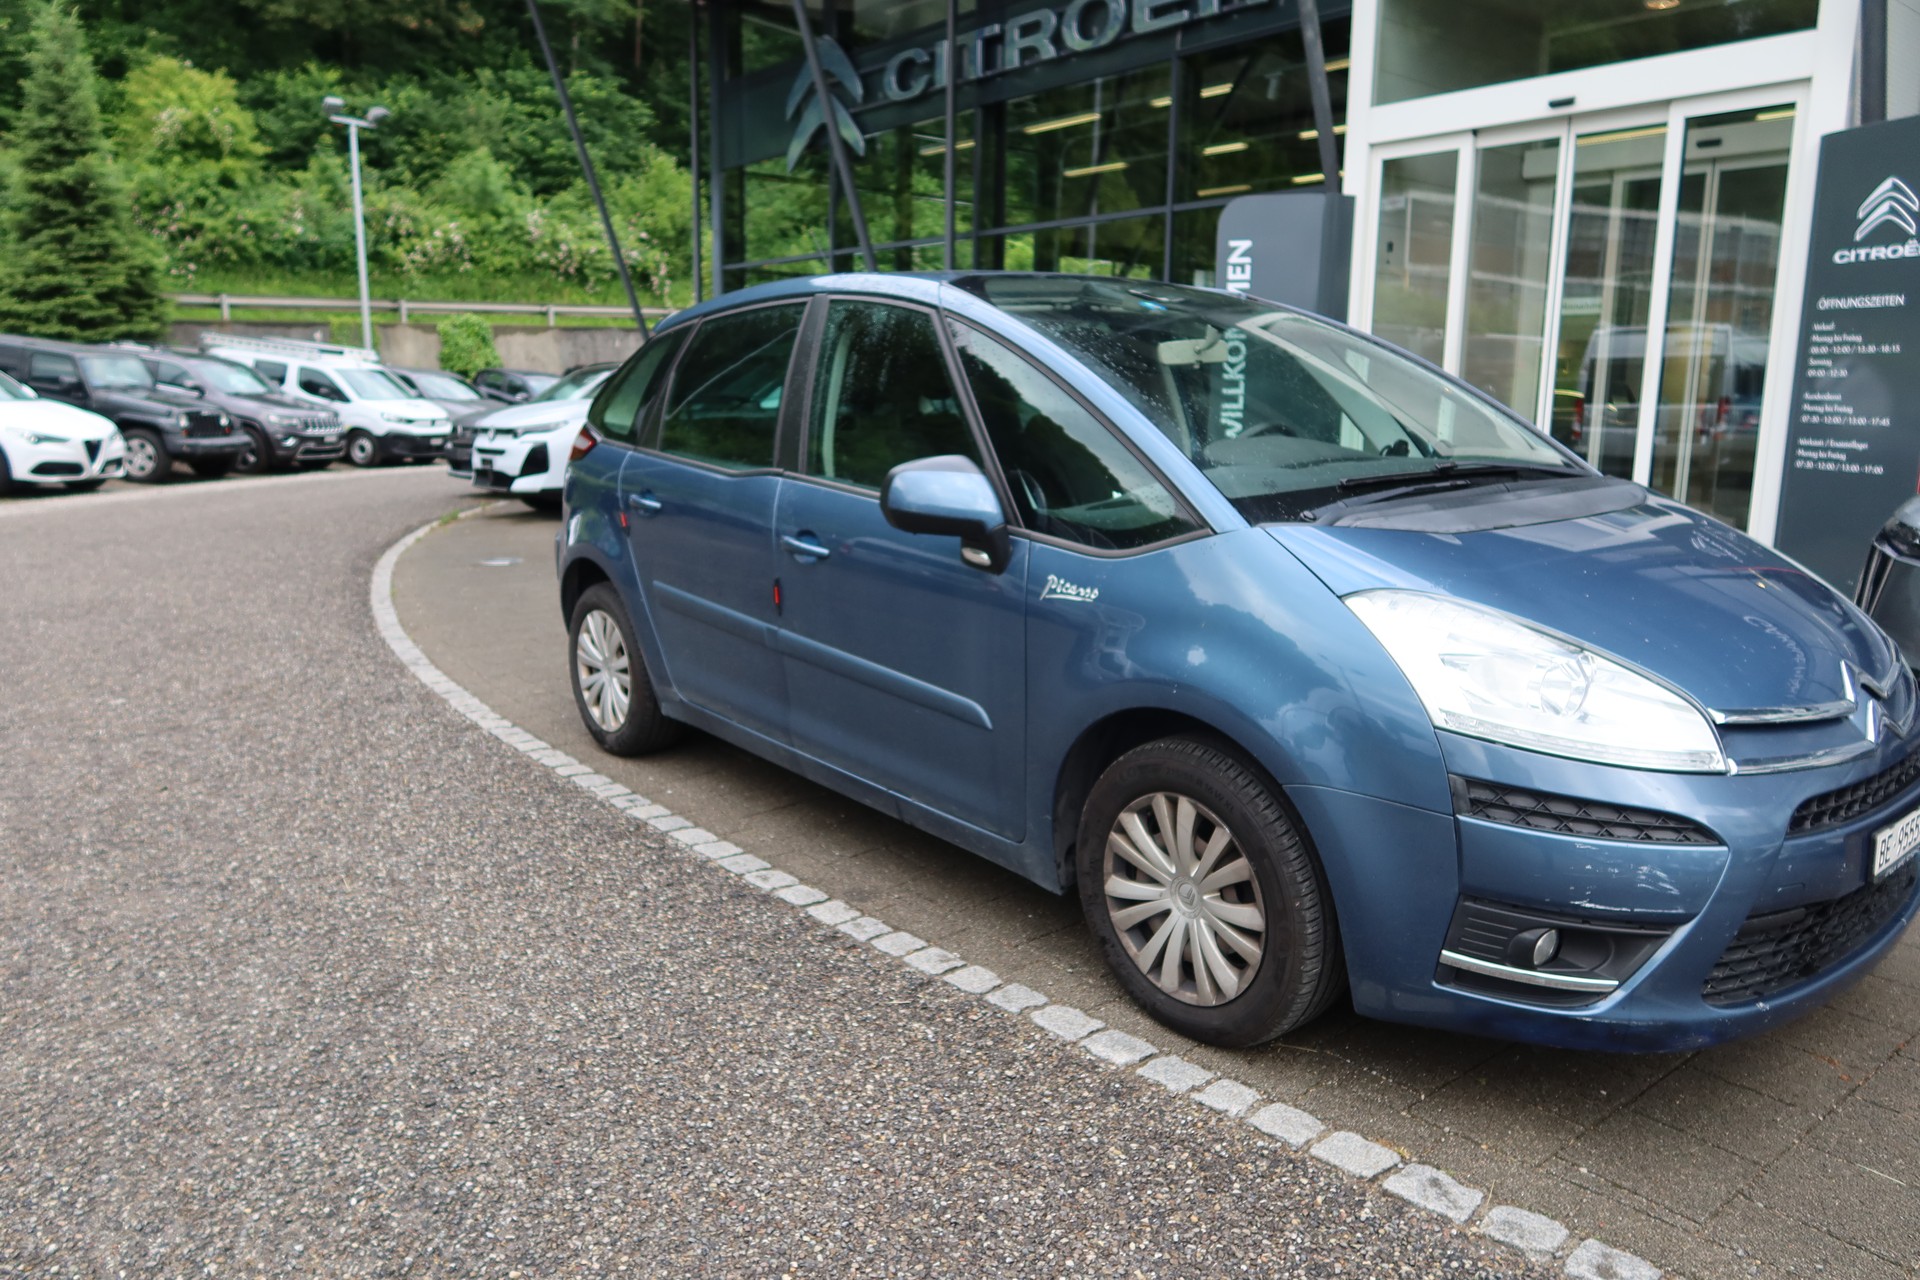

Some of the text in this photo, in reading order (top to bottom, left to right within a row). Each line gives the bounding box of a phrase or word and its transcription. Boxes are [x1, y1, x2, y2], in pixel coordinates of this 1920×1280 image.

[884, 0, 1274, 100] CITRO
[1817, 294, 1905, 310] ÖFFNUNGSZEITEN
[1040, 574, 1099, 602] Picasso
